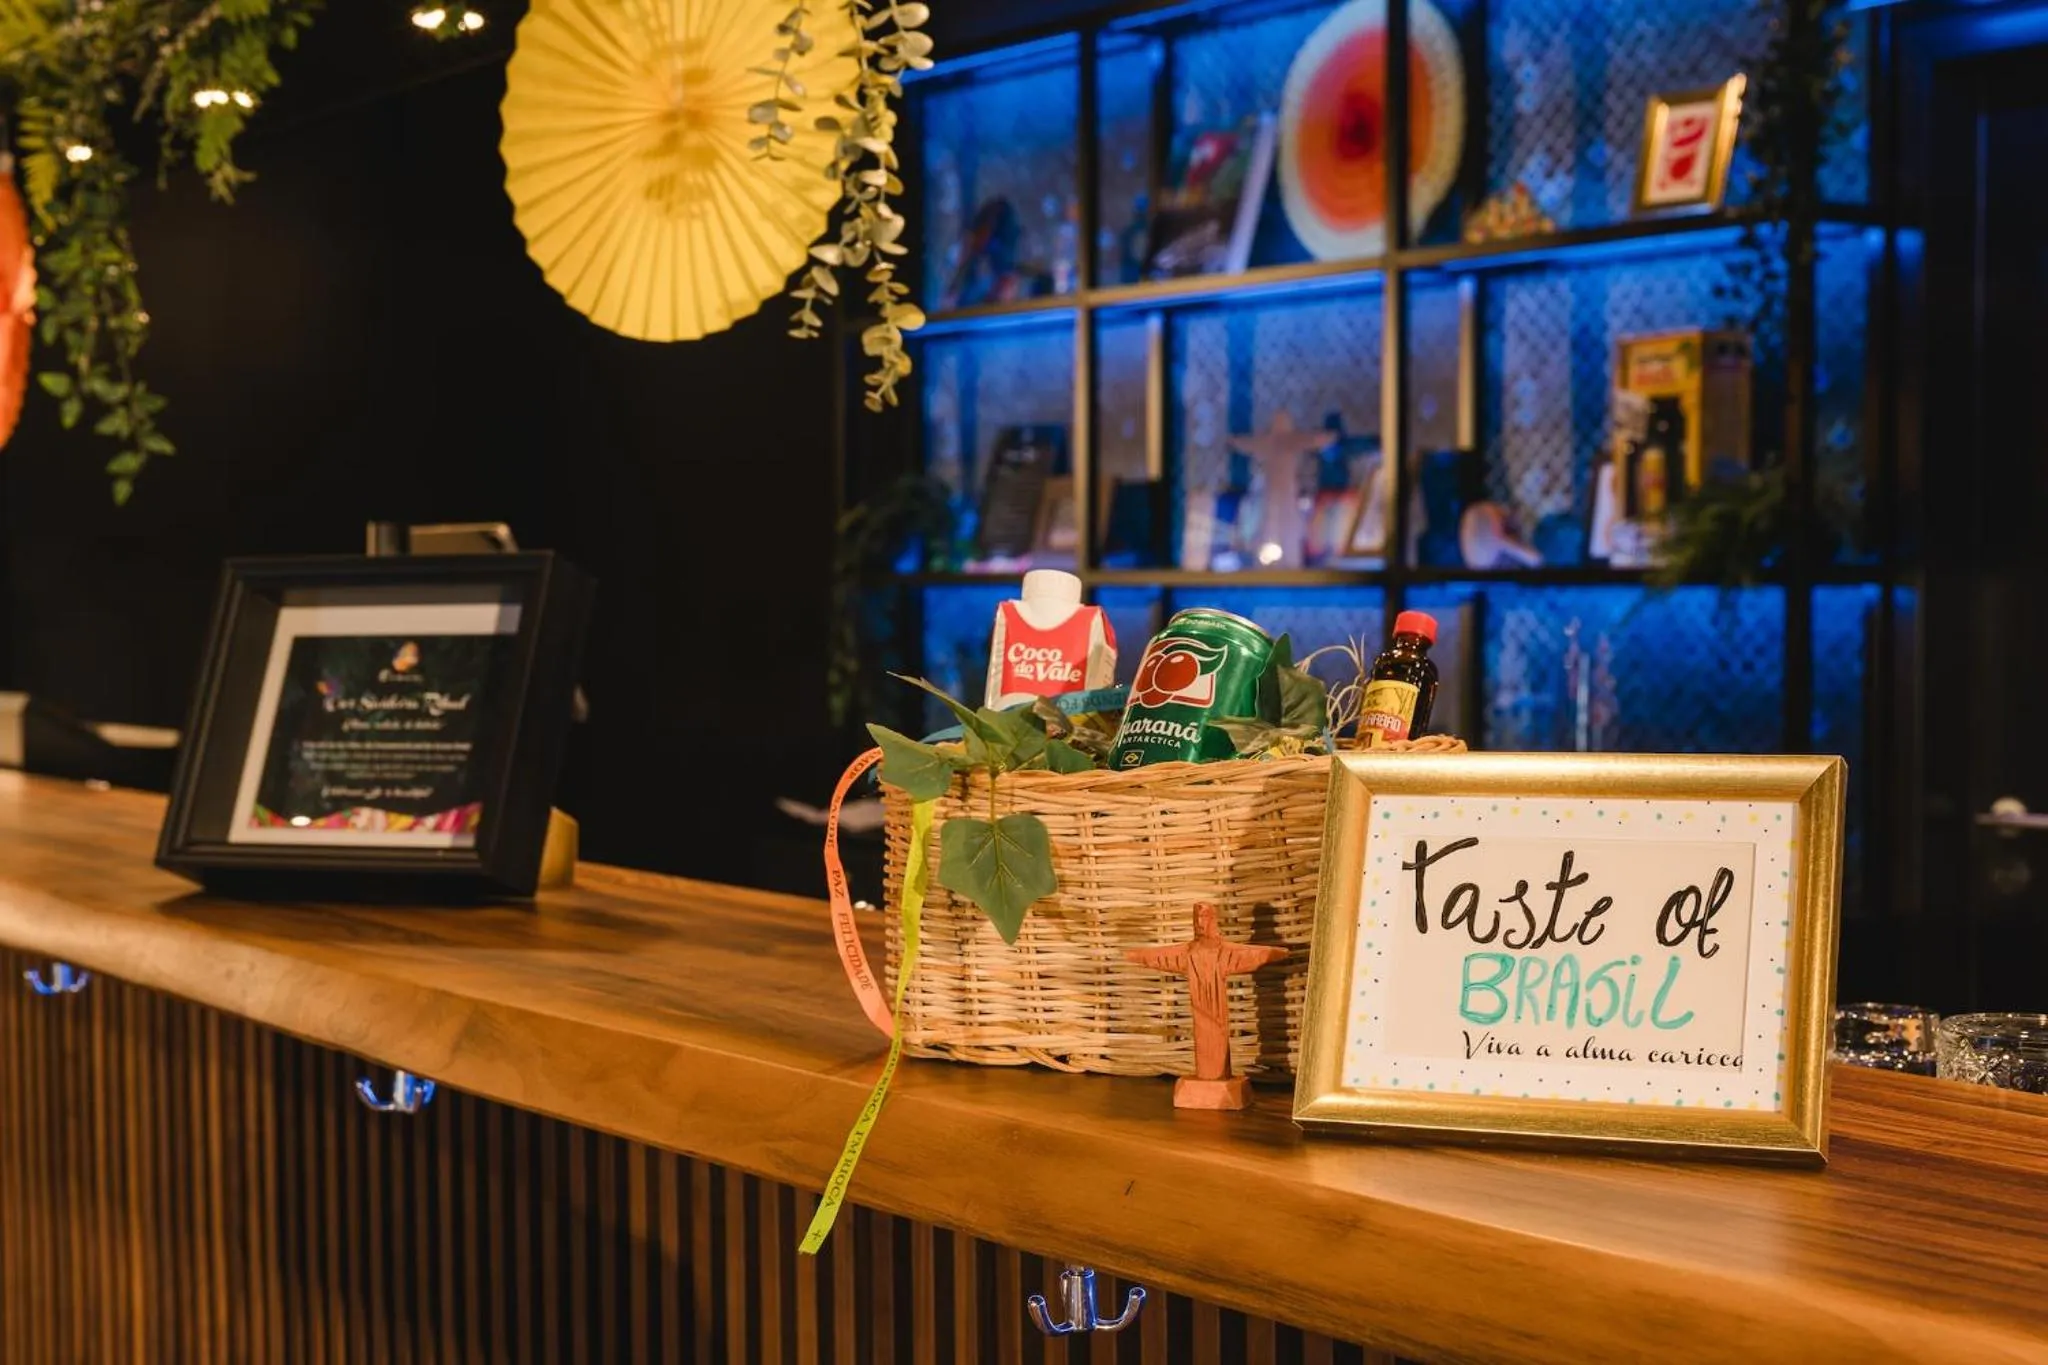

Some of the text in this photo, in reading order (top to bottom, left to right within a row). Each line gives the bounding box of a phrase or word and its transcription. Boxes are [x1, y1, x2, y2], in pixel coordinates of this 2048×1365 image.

[1007, 641, 1063, 663] Coco
[1034, 661, 1083, 683] Vale
[832, 868, 845, 899] PAZ
[1402, 837, 1613, 949] Taste
[838, 911, 874, 992] FELICIDADE
[1462, 1030, 1744, 1067] Viva a alma carioca
[824, 1158, 854, 1209] RIOCA
